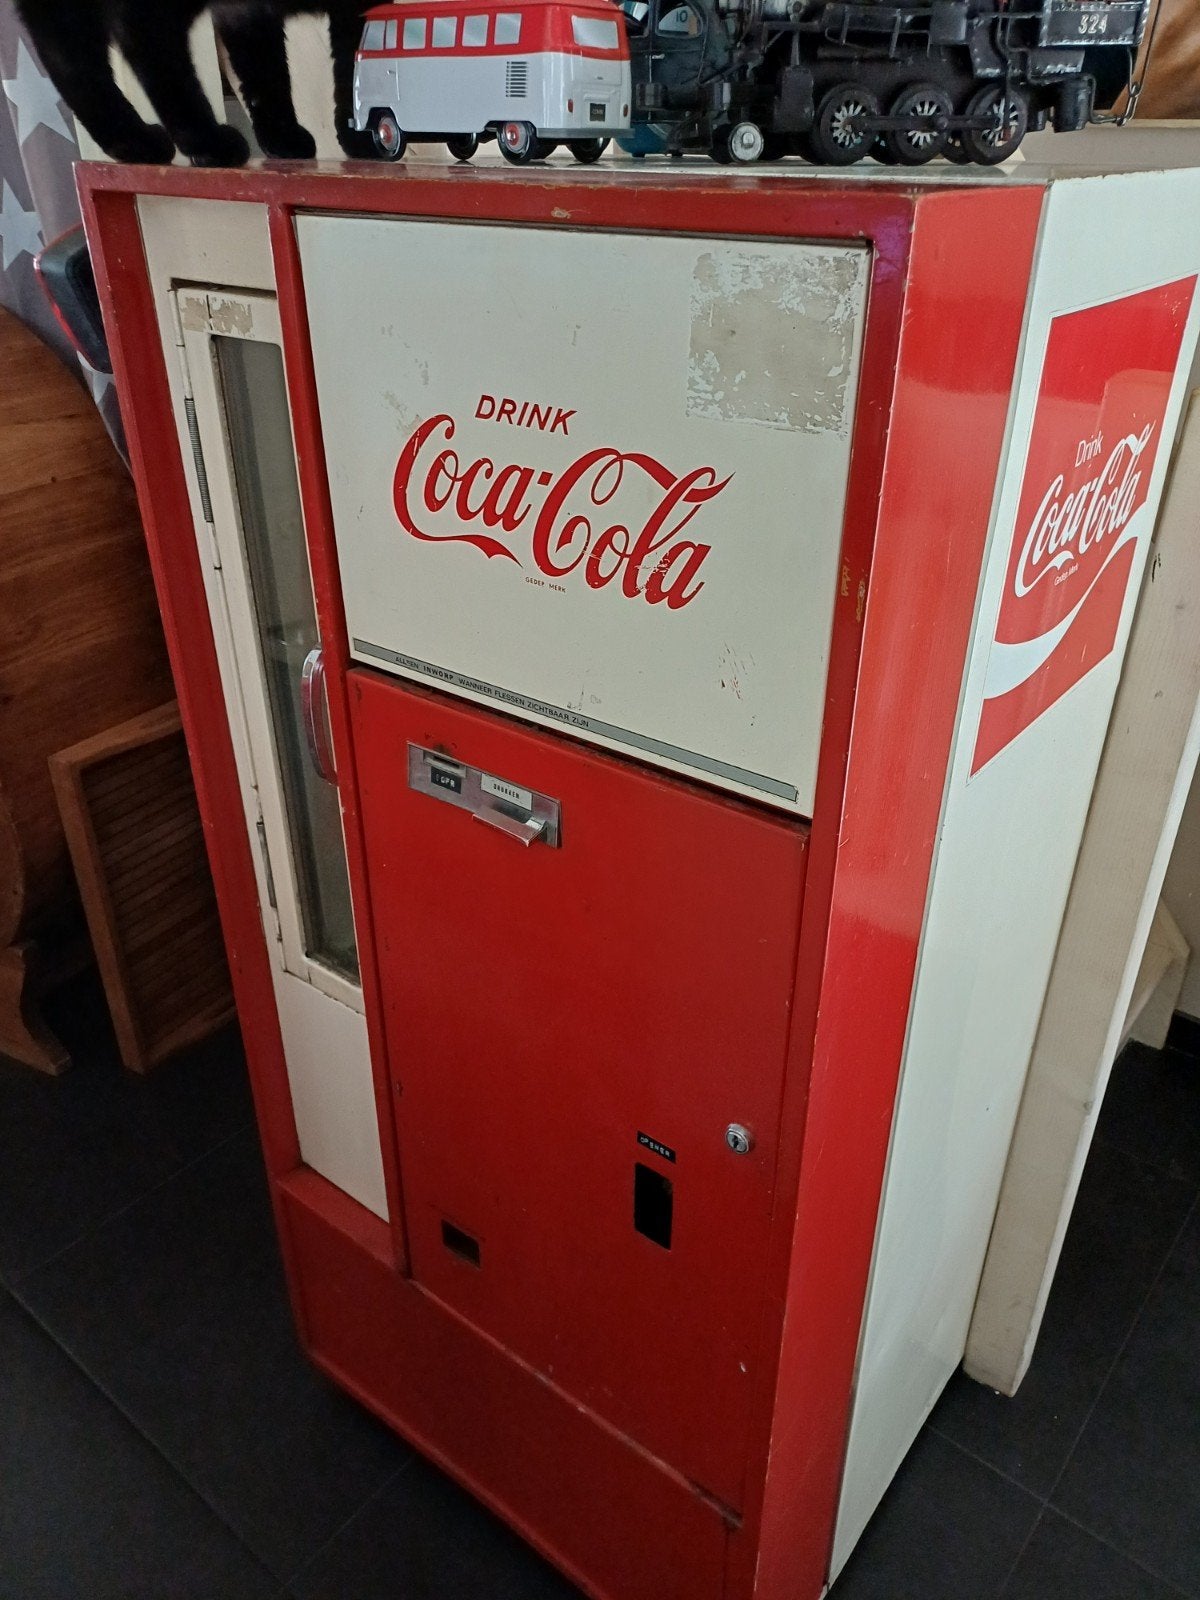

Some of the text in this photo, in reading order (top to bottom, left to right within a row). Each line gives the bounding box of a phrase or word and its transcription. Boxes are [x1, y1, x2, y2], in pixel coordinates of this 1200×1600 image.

[474, 393, 578, 435] DRINK
[1075, 429, 1104, 468] Drink
[393, 413, 736, 610] Coca-Cola
[1014, 420, 1156, 598] Coca-Cola
[549, 583, 567, 593] MERK
[458, 678, 493, 694] WANNEER
[494, 689, 525, 706] FLESSEN
[527, 700, 570, 720] ZICHTBAAR
[572, 716, 589, 728] ZIJN
